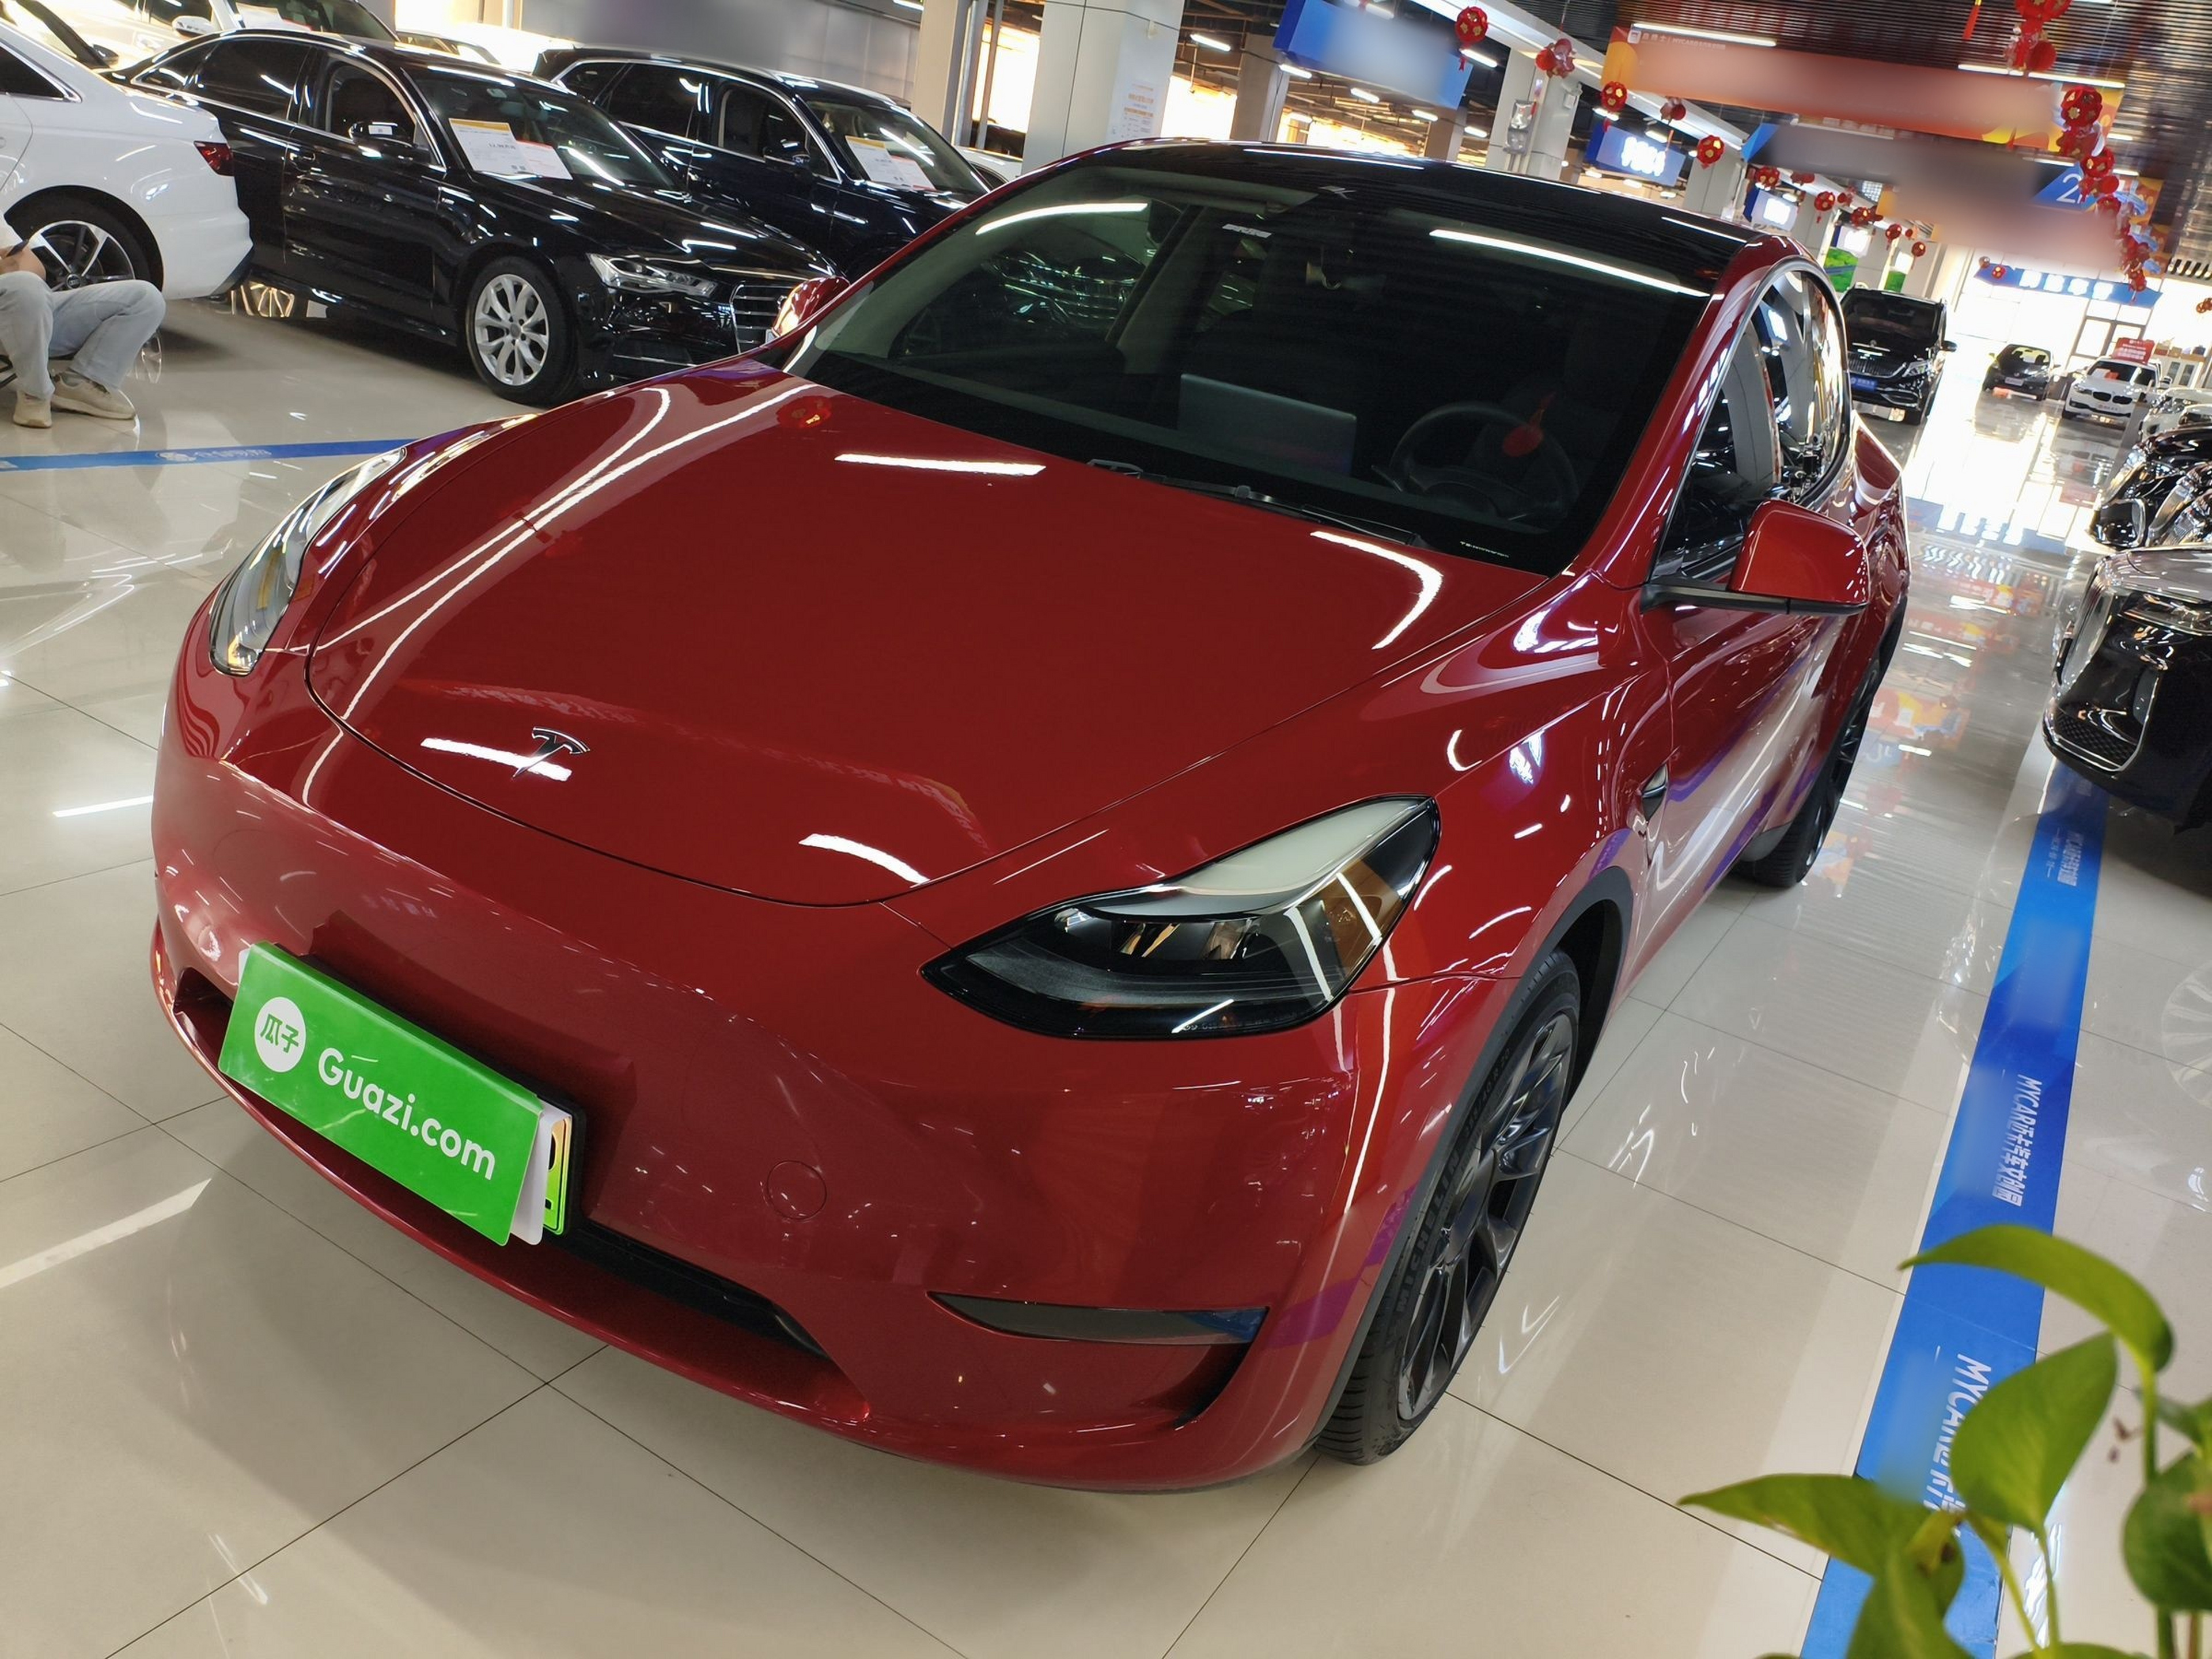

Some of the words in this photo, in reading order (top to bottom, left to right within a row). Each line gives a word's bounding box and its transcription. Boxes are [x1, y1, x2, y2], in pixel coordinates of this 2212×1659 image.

[260, 1013, 300, 1054] 瓜子
[318, 1047, 496, 1180] Guazi.com
[1396, 1149, 1461, 1313] MICHELIN
